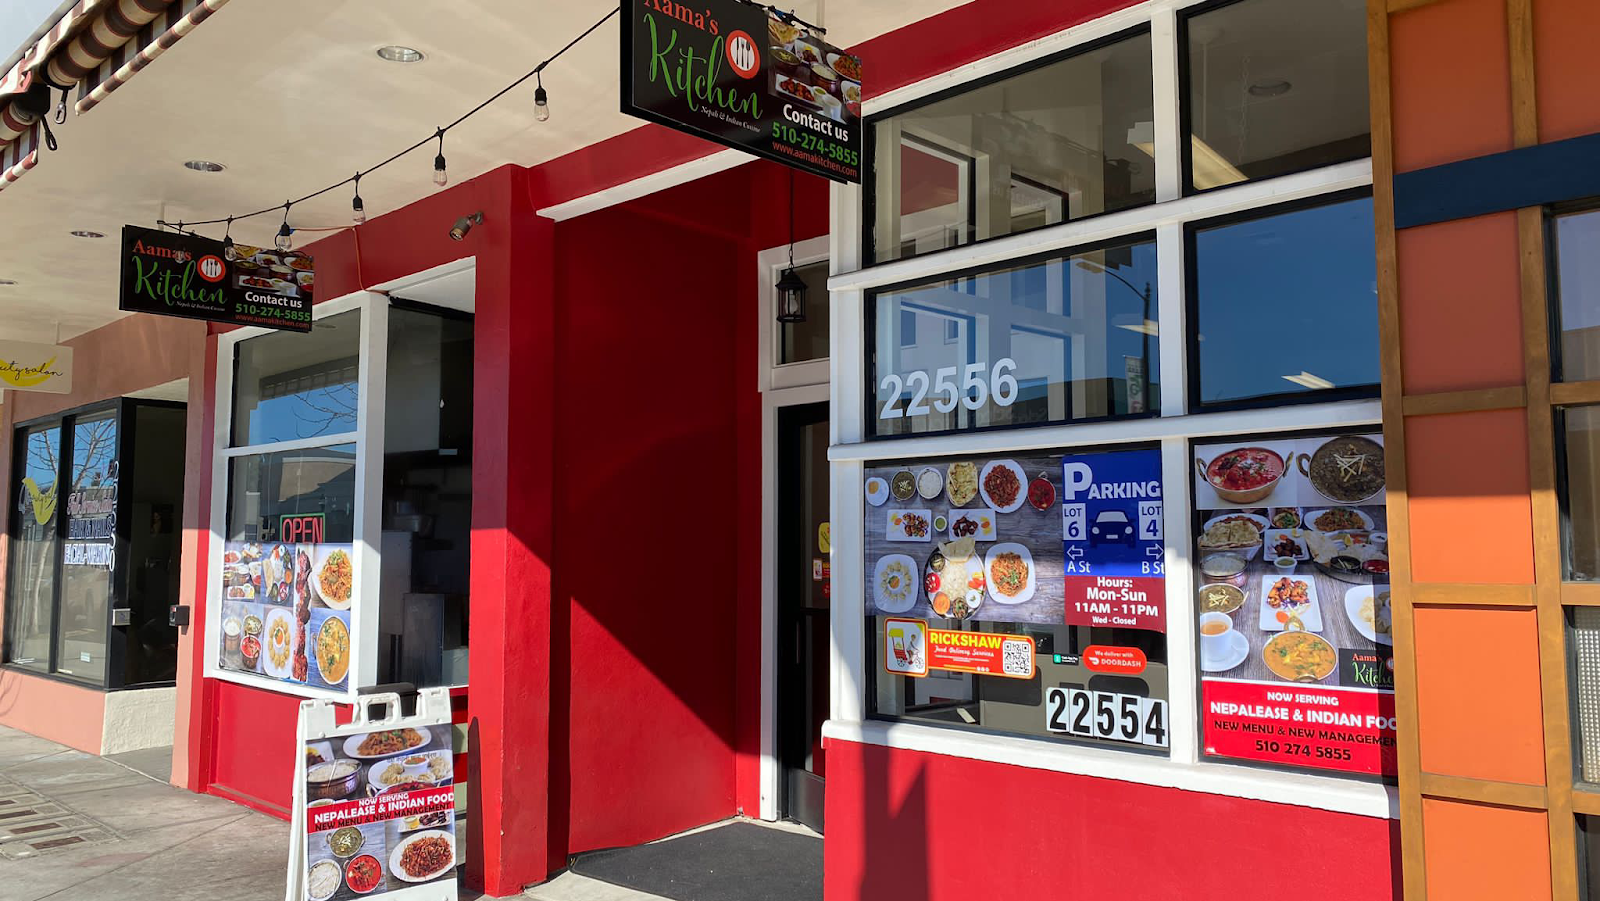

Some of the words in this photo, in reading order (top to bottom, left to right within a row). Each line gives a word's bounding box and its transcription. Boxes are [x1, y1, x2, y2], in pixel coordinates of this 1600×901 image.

[643, 13, 763, 119] Kitchen
[783, 104, 832, 136] Contact
[835, 126, 849, 142] us
[772, 122, 858, 166] 510-274-5855
[772, 140, 858, 178] www.aamakitchen.com
[132, 239, 192, 261] Aama's
[131, 255, 228, 306] Kitchen
[245, 291, 288, 307] Contact
[290, 298, 302, 308] us
[235, 302, 311, 322] 510-274-5855
[235, 313, 310, 329] www.aamakitchen.com
[879, 357, 1019, 419] 22556
[1063, 461, 1161, 500] PARKING
[1064, 508, 1082, 518] LOT
[1141, 506, 1161, 516] LOT
[281, 517, 323, 543] OPEN
[1068, 521, 1080, 538] 6
[1146, 519, 1159, 537] 4
[1067, 562, 1076, 573] A
[1078, 561, 1091, 573] St
[1141, 562, 1150, 574] B
[1153, 562, 1165, 575] St
[1097, 576, 1133, 588] Hours:
[1087, 587, 1147, 602] Mon-Sun
[1074, 602, 1111, 614] 11AM
[1122, 604, 1158, 617] 11PM
[1092, 616, 1107, 624] Wed
[1112, 616, 1136, 625] Closed
[930, 632, 1001, 649] RICKSHAW
[1101, 658, 1141, 667] DOORDASH
[1352, 661, 1393, 688] Kitche
[1267, 691, 1293, 703] NOW
[1294, 692, 1339, 706] SERVING
[1048, 688, 1166, 744] 22554
[1210, 702, 1290, 720] NEPALEASE
[1294, 709, 1304, 722] &
[1306, 710, 1362, 728] INDIAN
[1366, 716, 1396, 730] FOO
[1214, 721, 1240, 731] NEW
[1242, 721, 1275, 735] MENU
[1277, 726, 1286, 736] &
[1288, 727, 1315, 739] NEW
[1318, 731, 1397, 747] MANAGEMEN
[1255, 740, 1280, 753] 510
[1284, 742, 1311, 757] 274
[1316, 745, 1352, 761] 5855
[314, 804, 376, 824] NEPALEASE
[378, 804, 386, 813] &
[388, 797, 425, 812] INDIAN
[427, 792, 454, 805] FOOD
[358, 796, 377, 807] NOW
[378, 792, 409, 803] SERVING
[315, 820, 339, 831] NEW
[338, 816, 362, 828] MENU
[364, 815, 371, 825] &
[372, 812, 396, 823] NEW
[393, 802, 450, 819] MANAGEMENT
